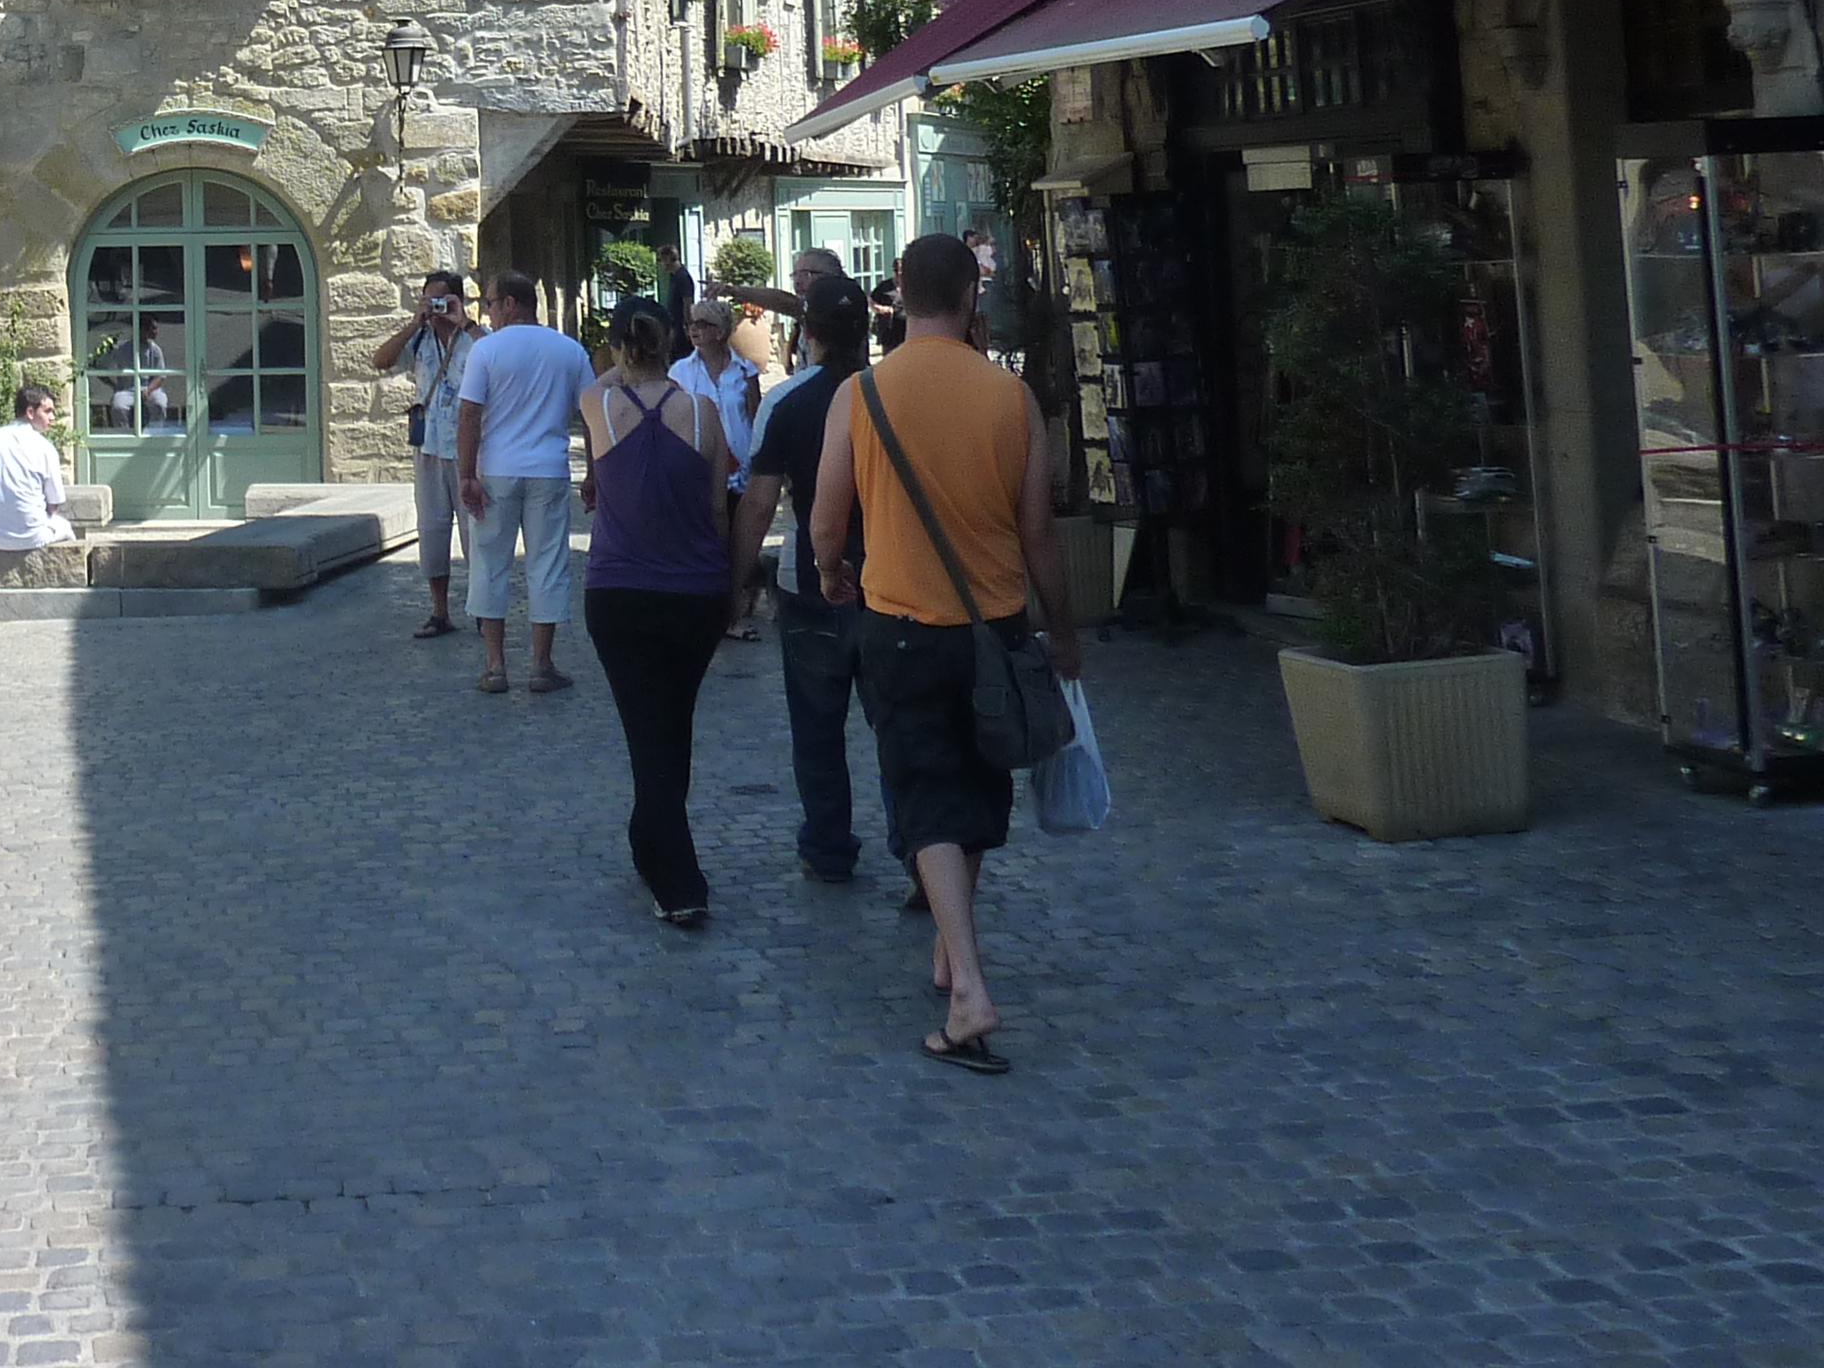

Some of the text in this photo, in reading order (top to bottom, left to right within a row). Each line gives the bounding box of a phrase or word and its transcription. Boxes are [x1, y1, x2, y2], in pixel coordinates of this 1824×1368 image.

[140, 119, 241, 141] Chez Saskia
[585, 179, 649, 199] Restaurant
